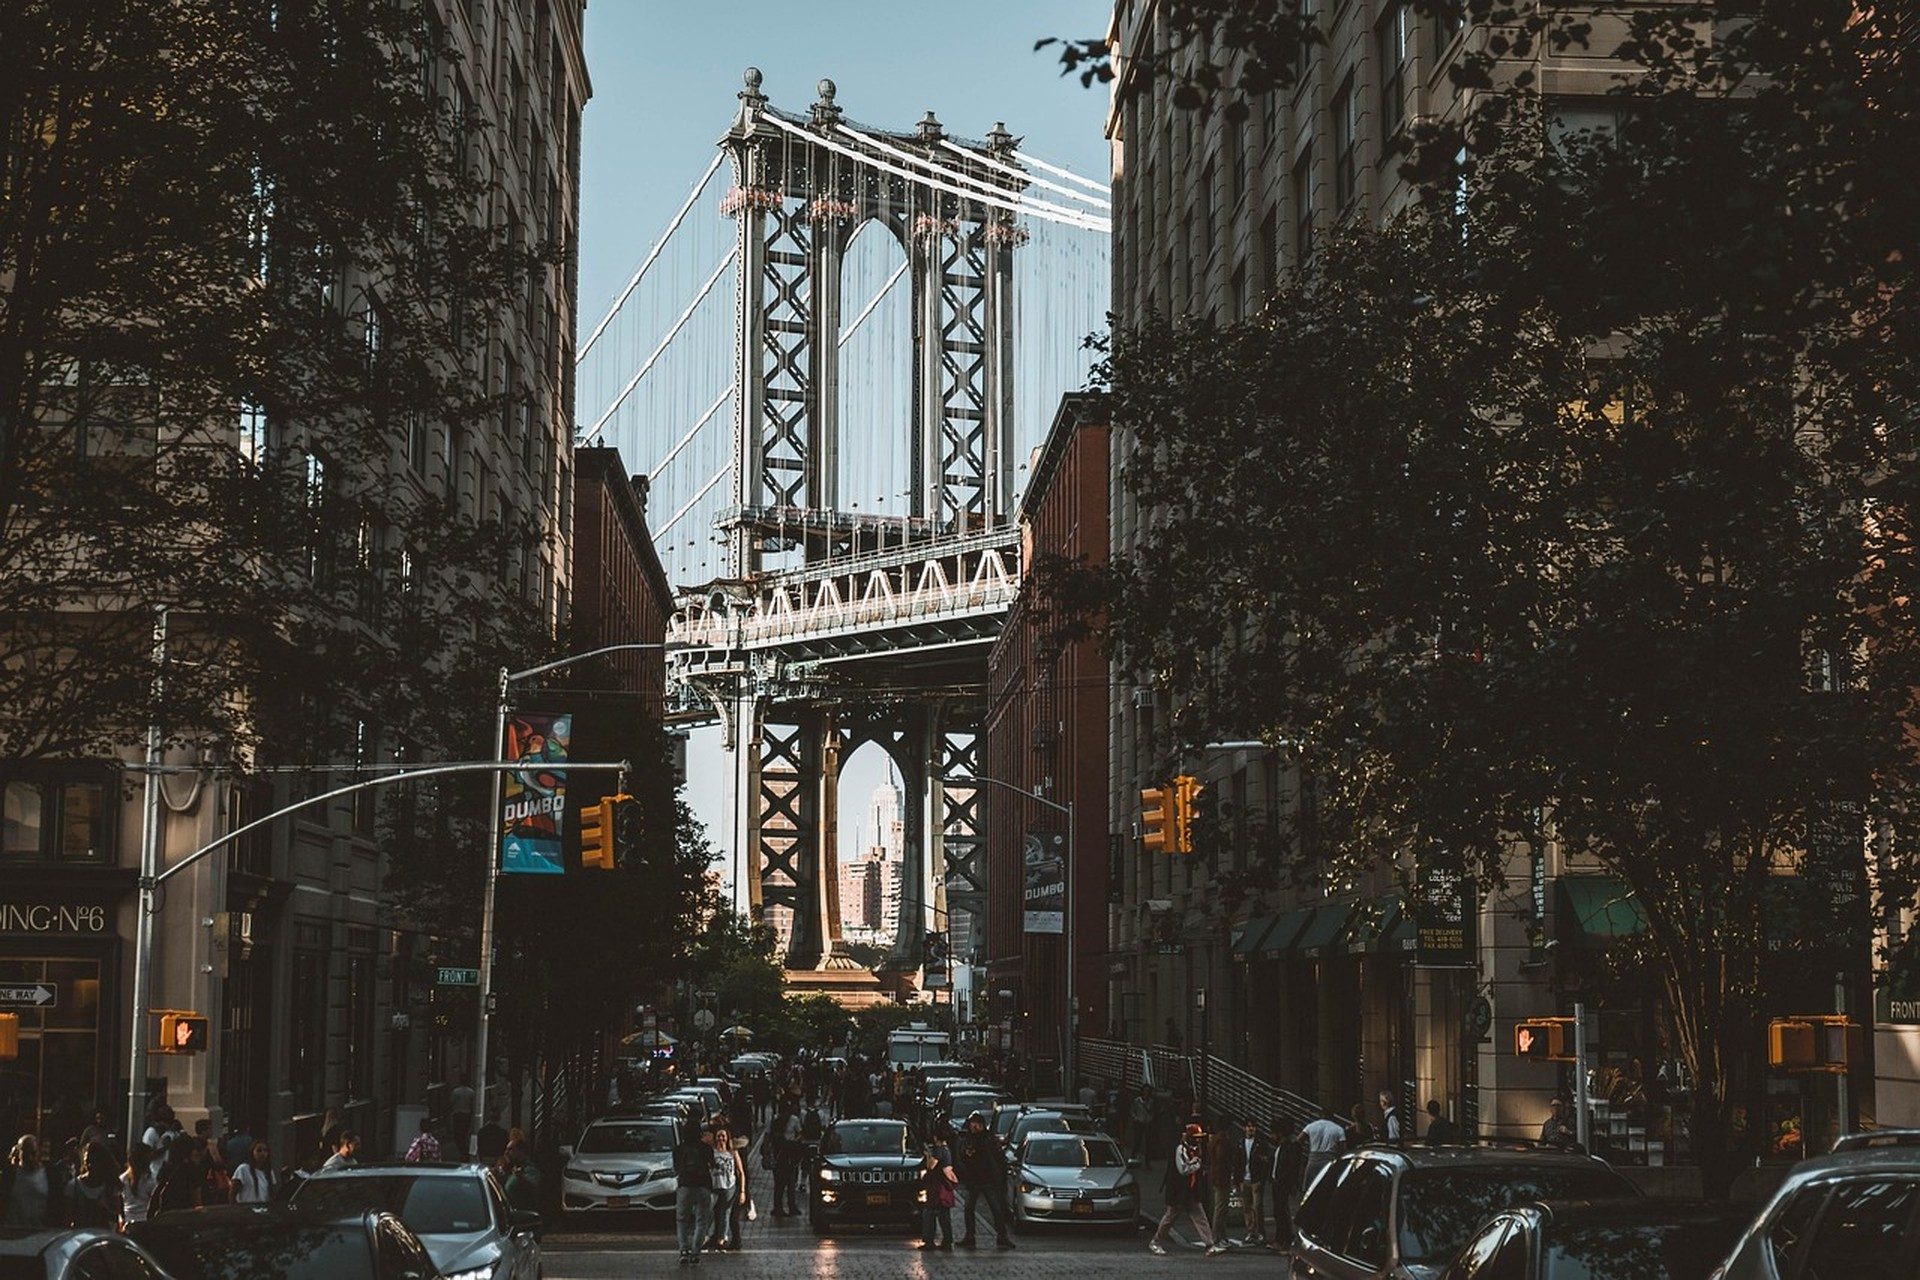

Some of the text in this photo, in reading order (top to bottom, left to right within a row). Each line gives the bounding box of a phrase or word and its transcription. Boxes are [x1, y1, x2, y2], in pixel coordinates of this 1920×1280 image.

[504, 795, 564, 821] DUMBO
[1025, 882, 1064, 900] DUMBO
[438, 970, 467, 983] FRONT
[15, 988, 36, 999] WAY
